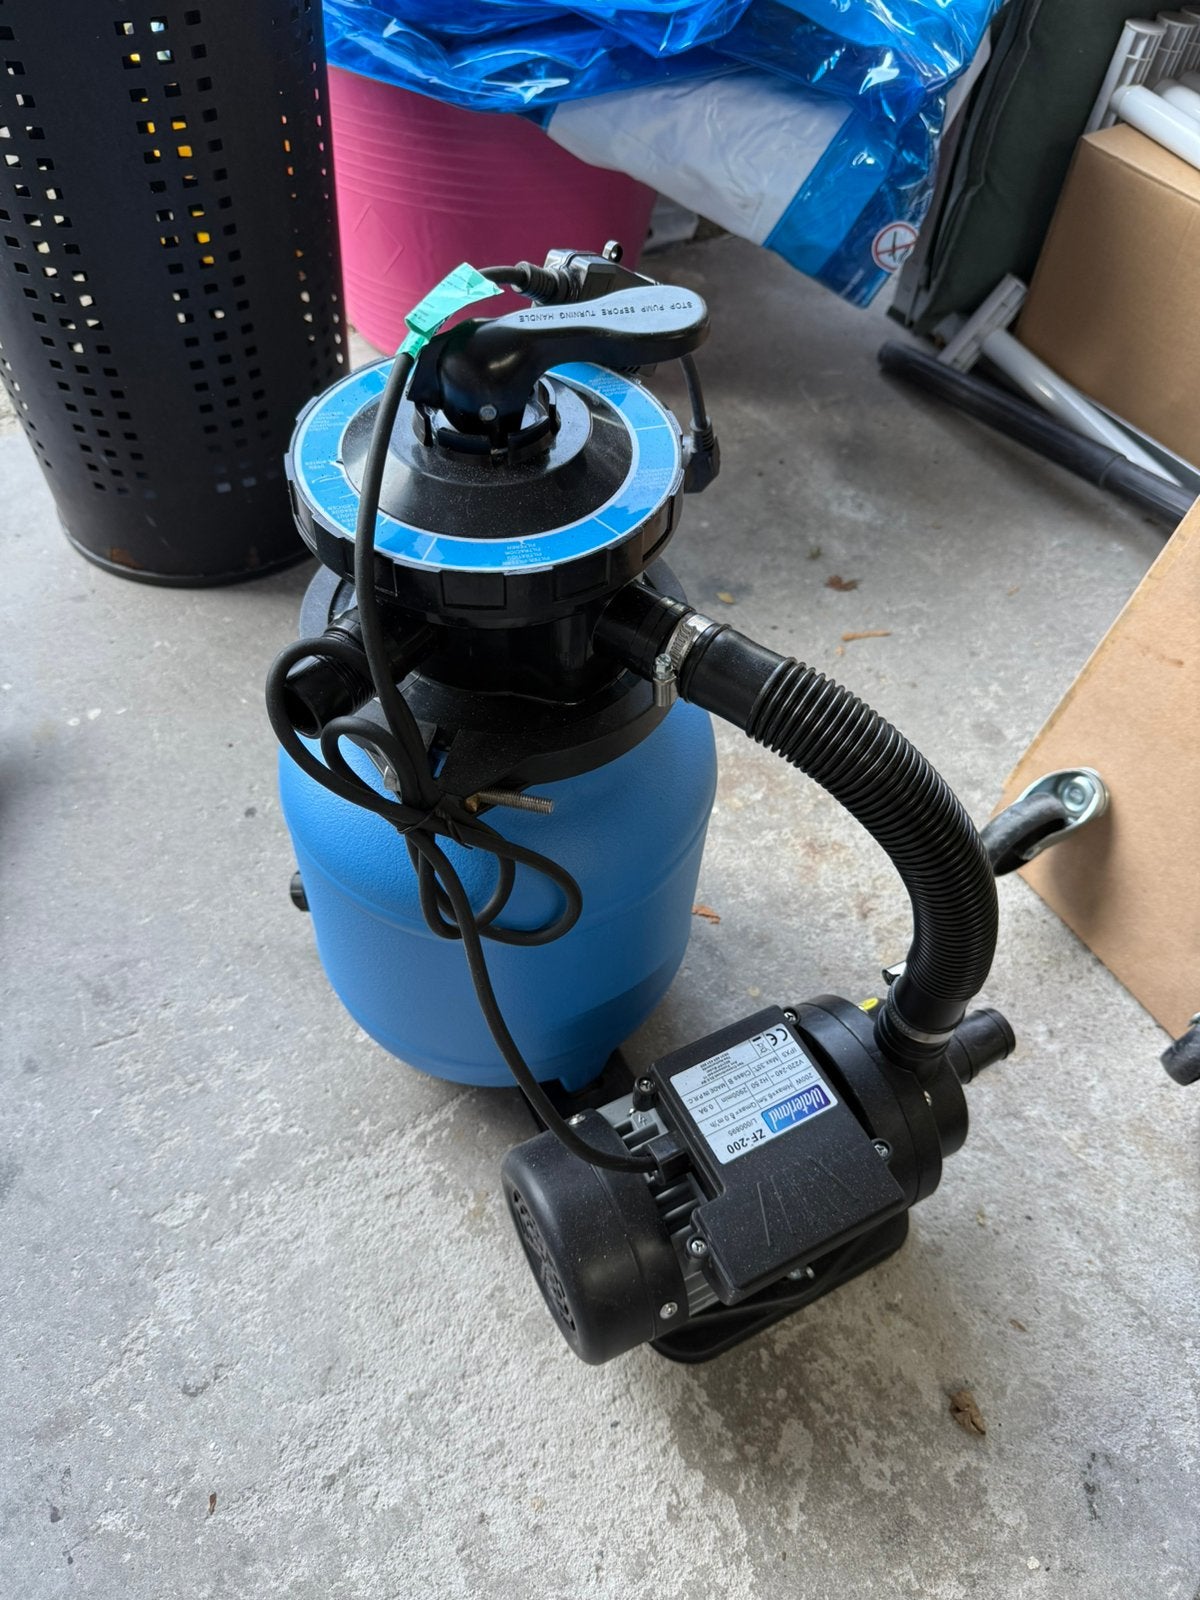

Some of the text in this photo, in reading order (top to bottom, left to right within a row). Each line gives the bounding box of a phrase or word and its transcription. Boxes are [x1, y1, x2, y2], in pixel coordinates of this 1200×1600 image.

[519, 301, 693, 323] STOP PUMP BEFORE TURNING HANDLE
[733, 1069, 751, 1081] Class
[750, 1075, 768, 1088] Hz 50
[795, 1072, 812, 1085] 200W
[709, 1082, 726, 1093] MADE
[768, 1087, 824, 1130] Waterland
[726, 1128, 765, 1154] ZF-200
